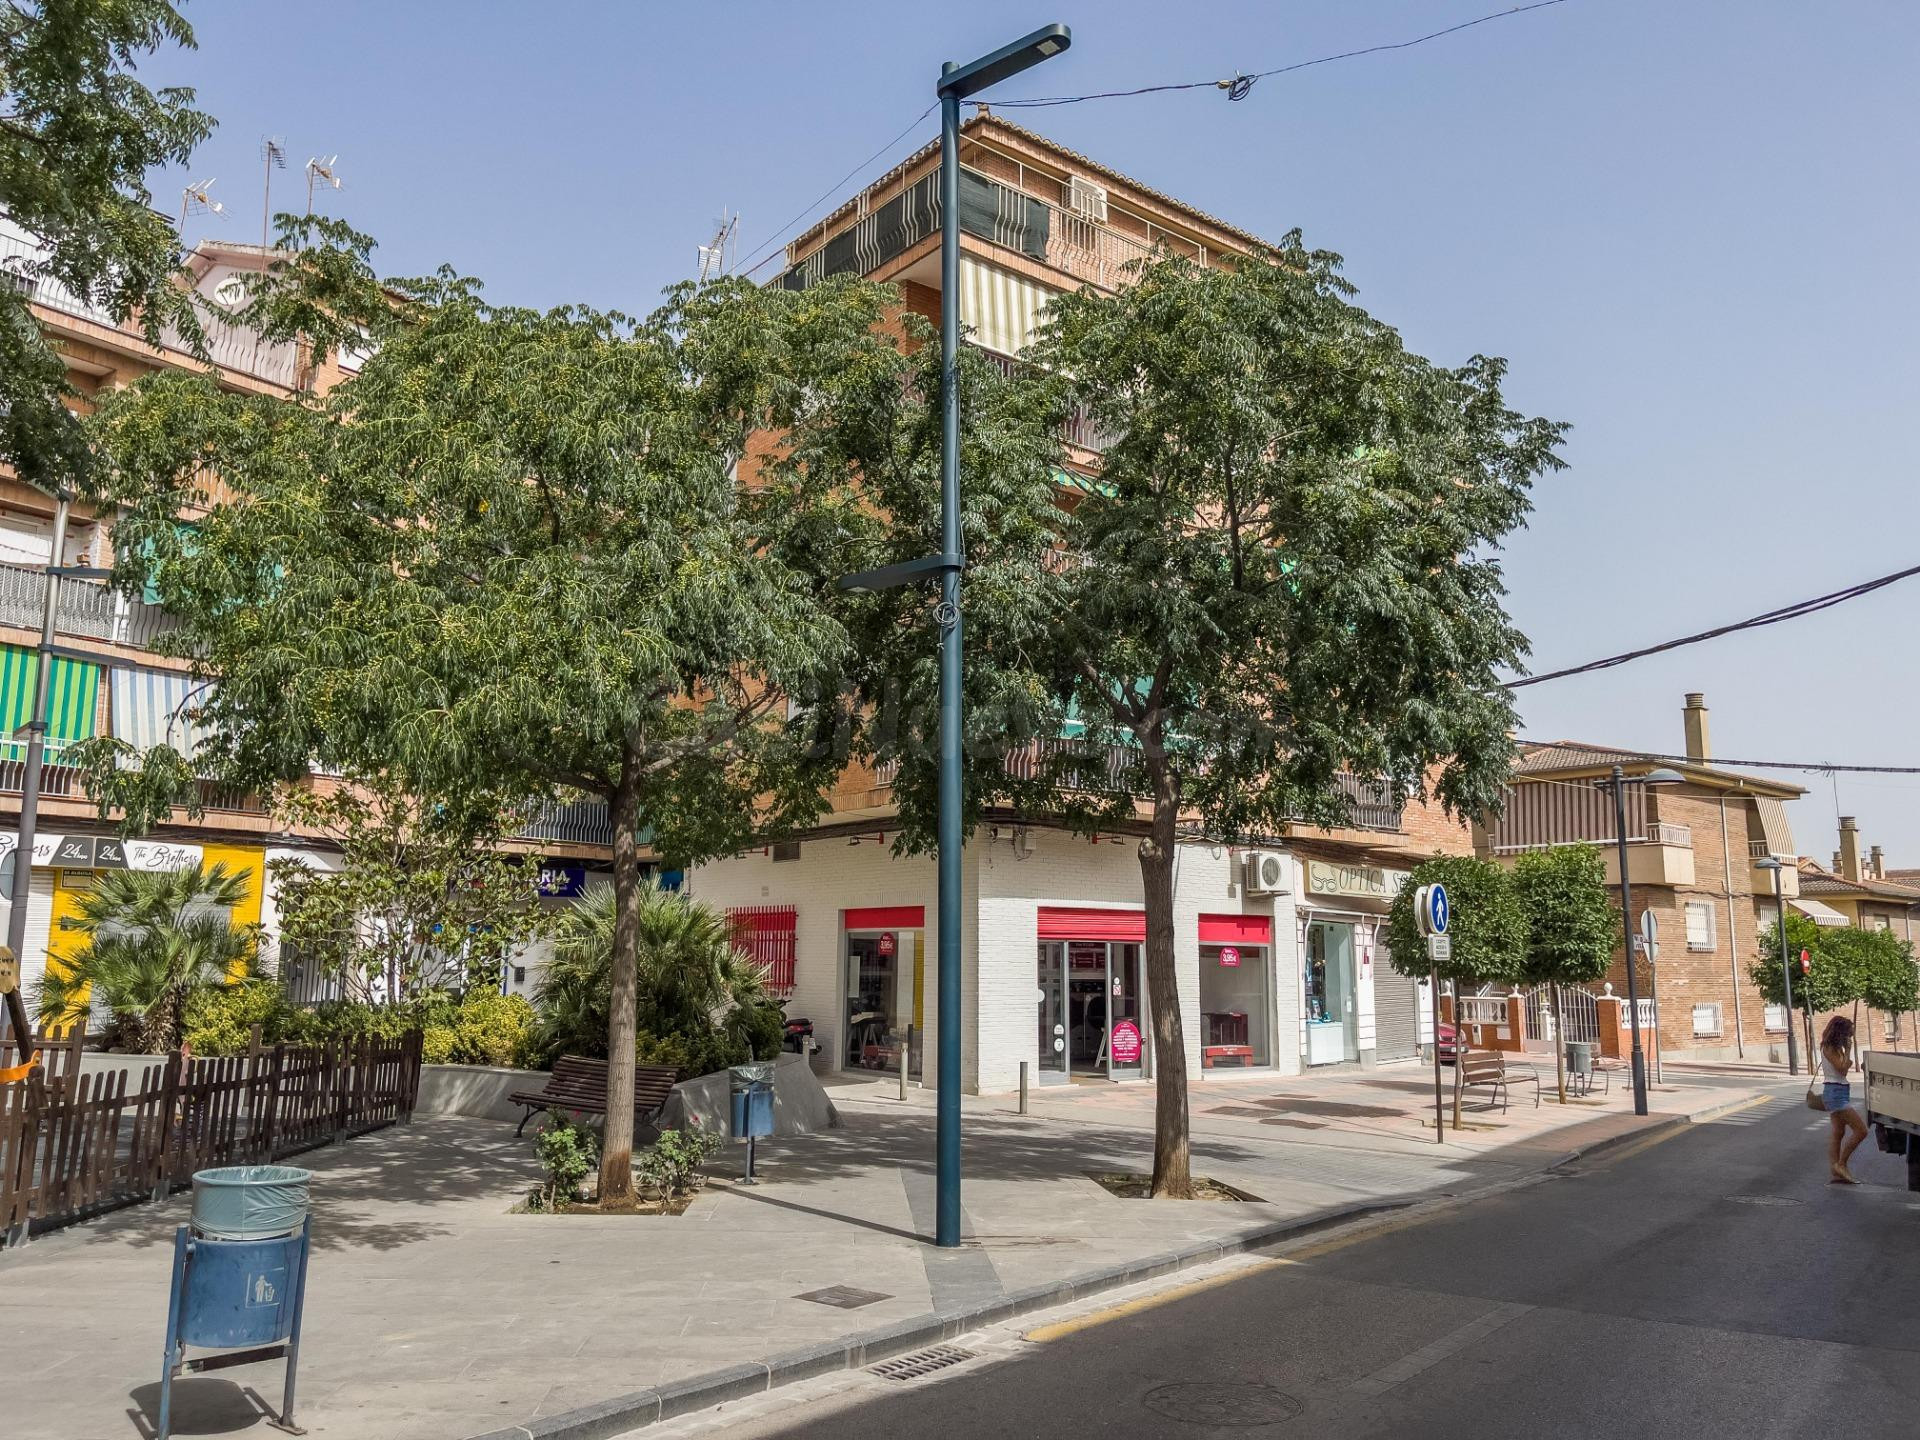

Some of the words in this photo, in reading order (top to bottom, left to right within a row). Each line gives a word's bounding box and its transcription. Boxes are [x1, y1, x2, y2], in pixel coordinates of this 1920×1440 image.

[0, 835, 50, 857] Brers
[134, 846, 148, 860] The
[146, 845, 198, 867] Brothers
